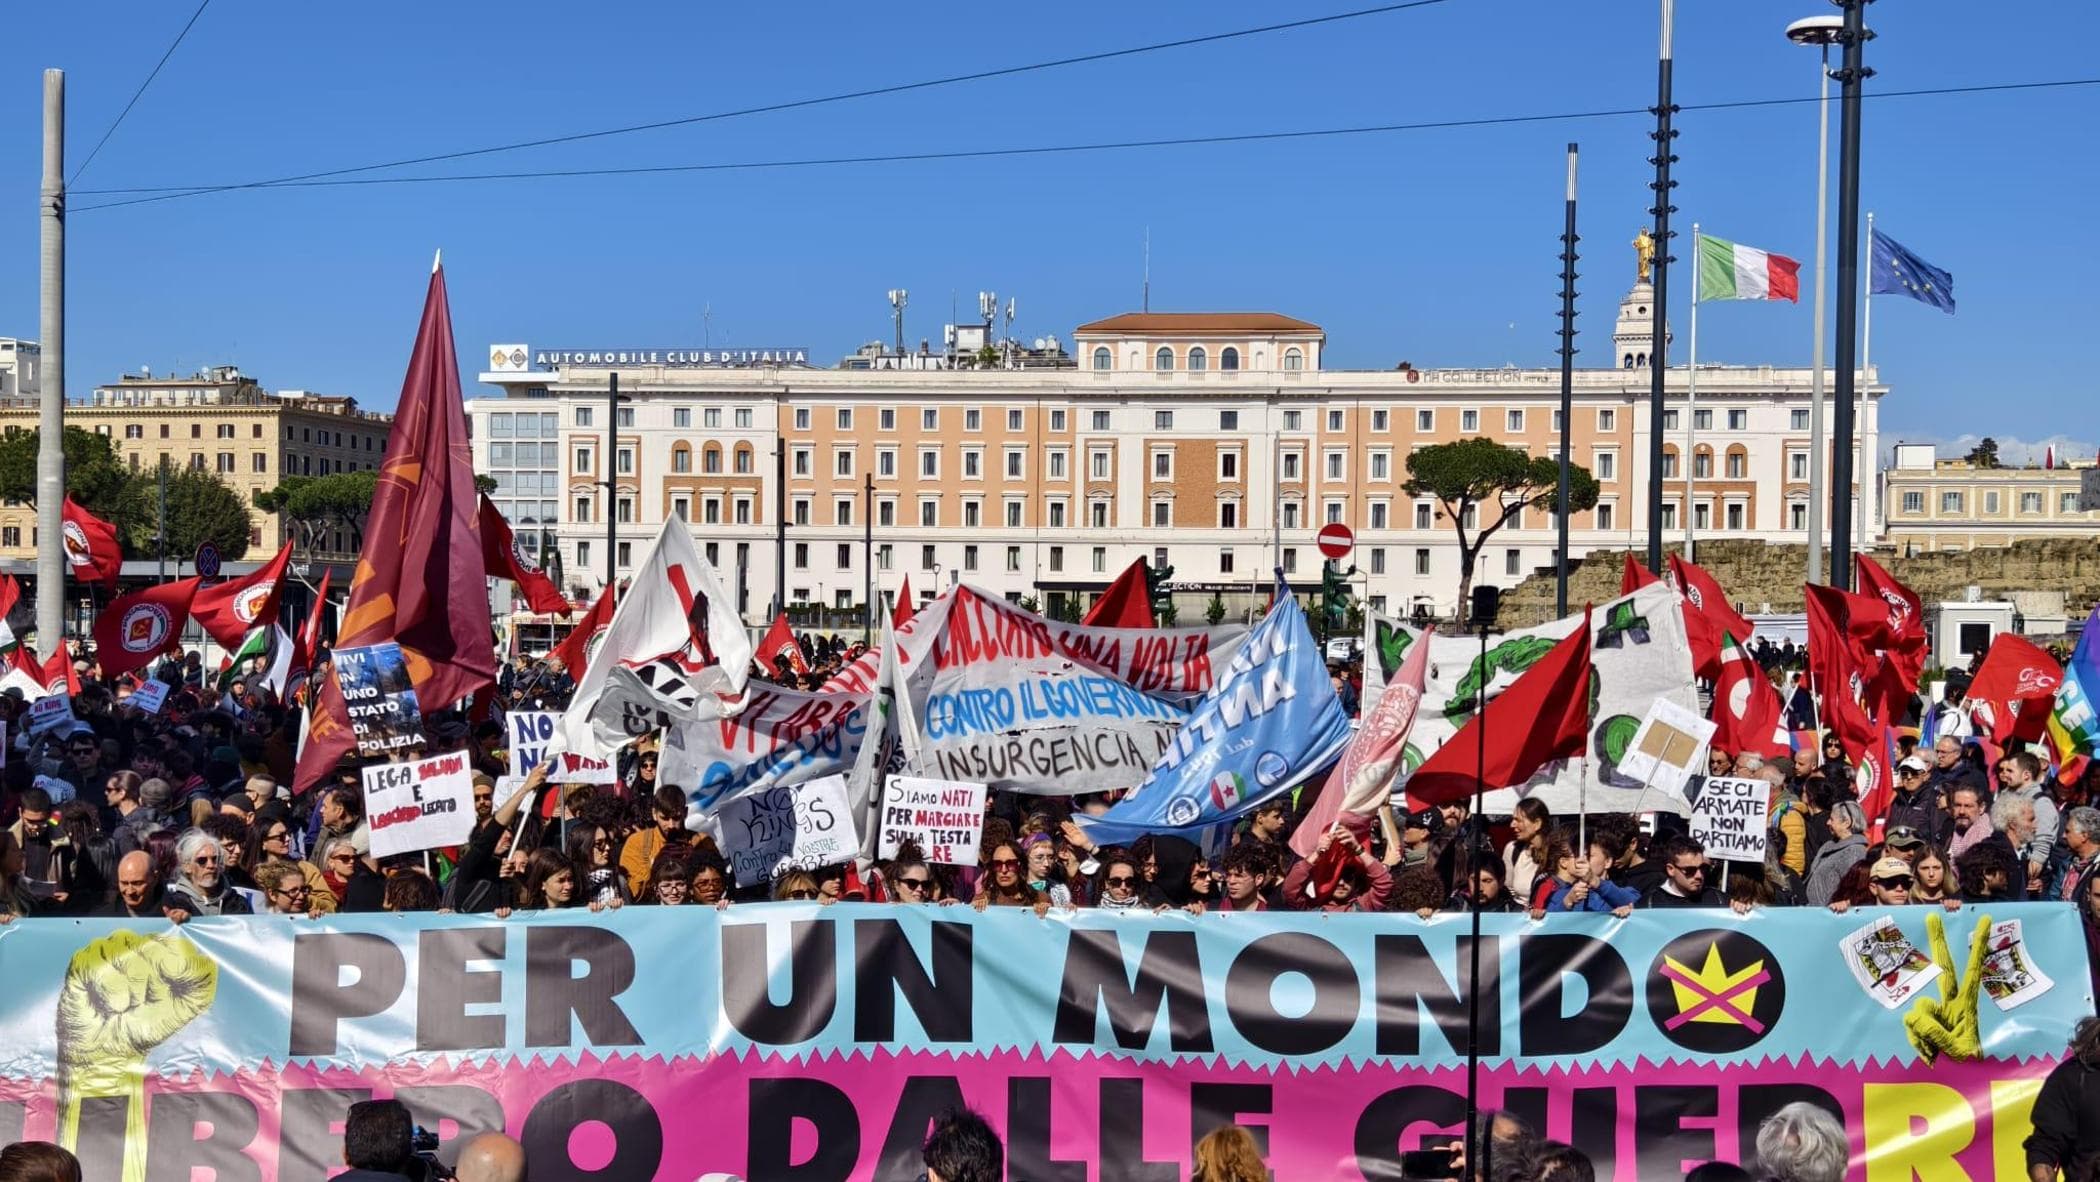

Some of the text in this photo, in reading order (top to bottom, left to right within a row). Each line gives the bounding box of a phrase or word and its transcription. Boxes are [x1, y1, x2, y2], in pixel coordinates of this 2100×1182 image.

[536, 351, 806, 364] AUTOMOBILE CLUB D'ITALIA
[1442, 371, 1522, 384] COLLECTION
[335, 652, 367, 666] VIVI
[1126, 632, 1214, 692] VOLTA
[339, 672, 356, 683] IN
[343, 687, 378, 700] UNO
[348, 701, 400, 718] STATO
[925, 686, 1016, 741] CONTRO
[353, 724, 370, 735] DI
[514, 713, 554, 745] NO
[358, 733, 427, 751] POLIZIA
[936, 732, 1149, 781] INSURGENCIA
[367, 766, 412, 794] LEGA
[1708, 779, 1754, 797] SE CI
[412, 783, 424, 803] E
[940, 789, 974, 808] NATI
[1692, 796, 1766, 816] ARMATE
[885, 806, 913, 826] PER
[1711, 816, 1746, 832] NON
[930, 829, 971, 845] TESTA
[1693, 829, 1766, 852] PARTIAMO
[932, 845, 953, 863] RE
[289, 918, 1786, 1057] PER UN MONDO
[747, 1075, 1275, 1182] DALLE
